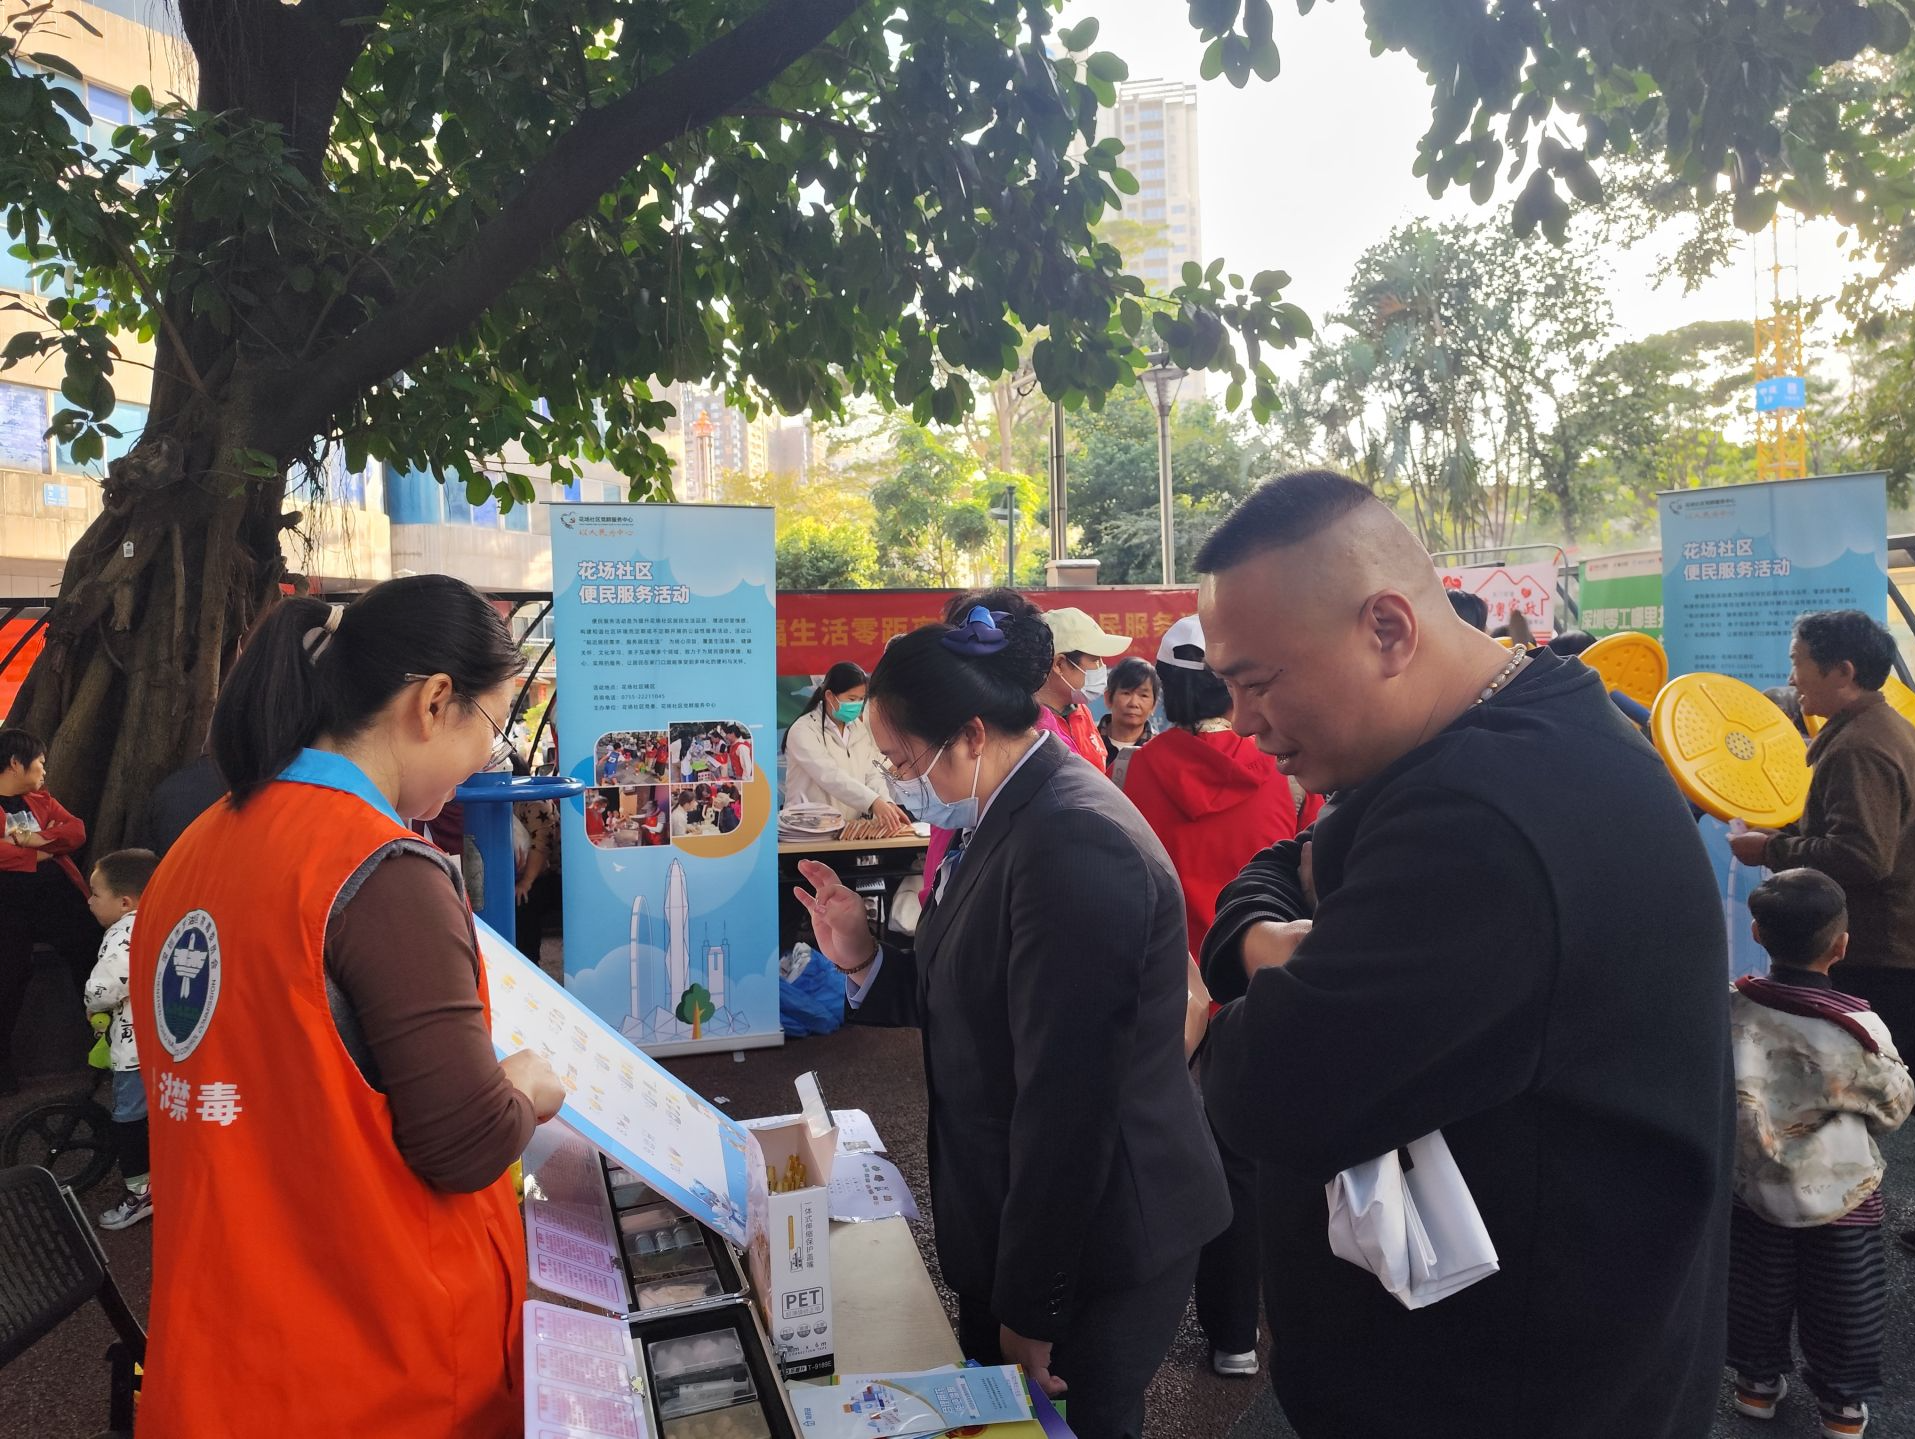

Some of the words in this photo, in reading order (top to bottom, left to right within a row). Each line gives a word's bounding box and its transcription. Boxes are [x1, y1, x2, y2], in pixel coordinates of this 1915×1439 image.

[1683, 538, 1754, 559] 花场社区
[578, 561, 653, 580] 花场社区
[1684, 559, 1791, 581] 便民服务活动
[579, 585, 691, 604] 便民服务活动
[159, 1072, 242, 1126] 禁毒
[786, 1289, 820, 1310] PET
